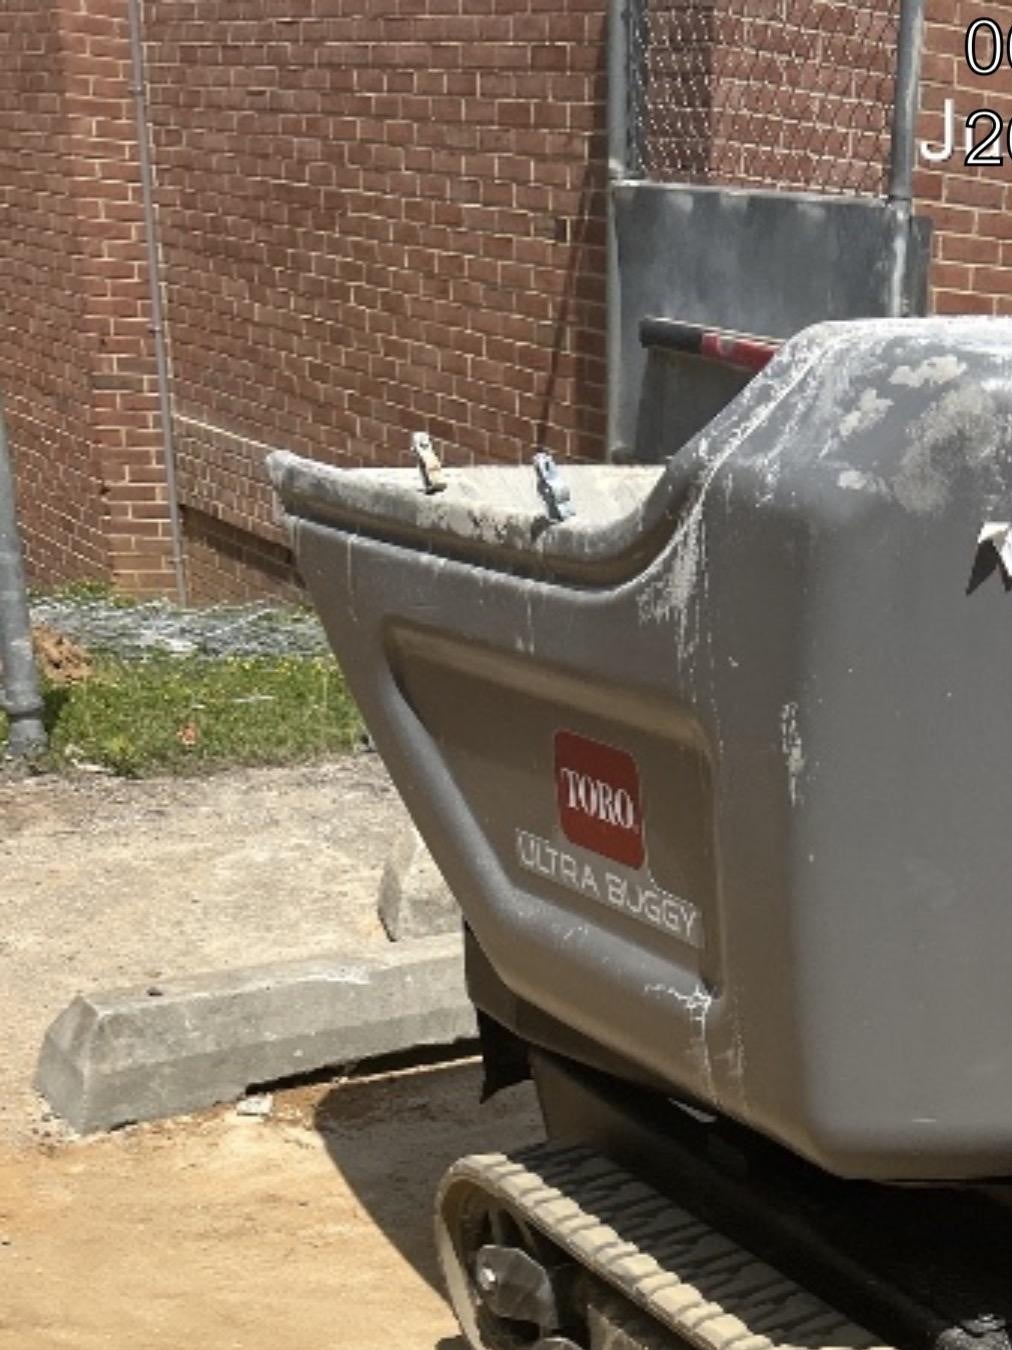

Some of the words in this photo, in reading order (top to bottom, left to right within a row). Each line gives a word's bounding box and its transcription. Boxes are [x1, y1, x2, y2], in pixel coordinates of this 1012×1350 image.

[560, 767, 635, 829] TORO
[517, 830, 600, 897] ULTRA
[604, 871, 698, 938] BUGGY
